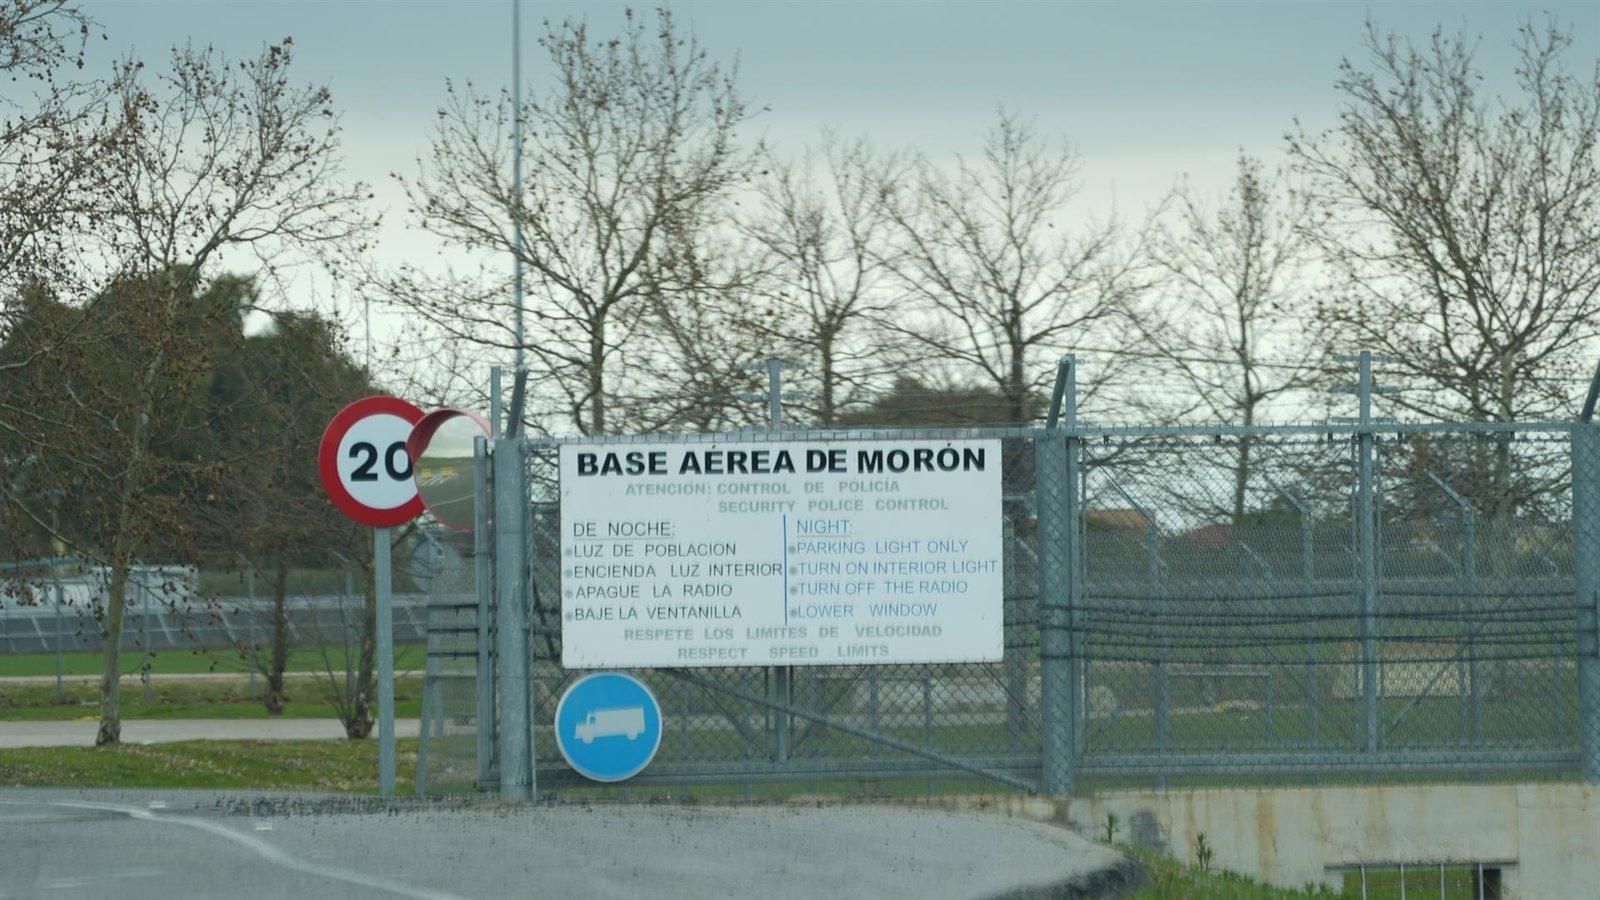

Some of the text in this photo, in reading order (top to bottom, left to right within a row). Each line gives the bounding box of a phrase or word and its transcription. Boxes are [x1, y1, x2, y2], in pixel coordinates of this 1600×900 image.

[348, 440, 414, 482] 20
[577, 442, 986, 476] BASE AÉREA DE MORÓN
[625, 478, 901, 496] ATENCIÓN: CONTROL DE POLICÍA
[718, 498, 949, 513] SECURITY POLICE CONTROL
[573, 521, 676, 537] DE NOCHE:
[796, 519, 852, 534] NIGHT:
[574, 544, 603, 558] LUZ
[613, 544, 634, 557] DE
[797, 540, 969, 555] PARKING LIGHT ONLY
[574, 563, 783, 578] ENCIENDA LUZ INTERIOR
[798, 560, 998, 576] TURN ON INTERIOR LIGHT
[575, 584, 733, 599] APAGUE LA RADIO
[798, 580, 968, 595] TURN OFF THE RADIO
[575, 605, 742, 621] BAJE LA VENTANILLA
[798, 603, 938, 619] LOWER WINDOW
[624, 628, 694, 641] RESPETE
[704, 628, 734, 640] LOS
[818, 626, 839, 638] DE
[855, 625, 942, 638] VELOCIDAD
[677, 645, 889, 659] RESPECT SPEED LIMITS
